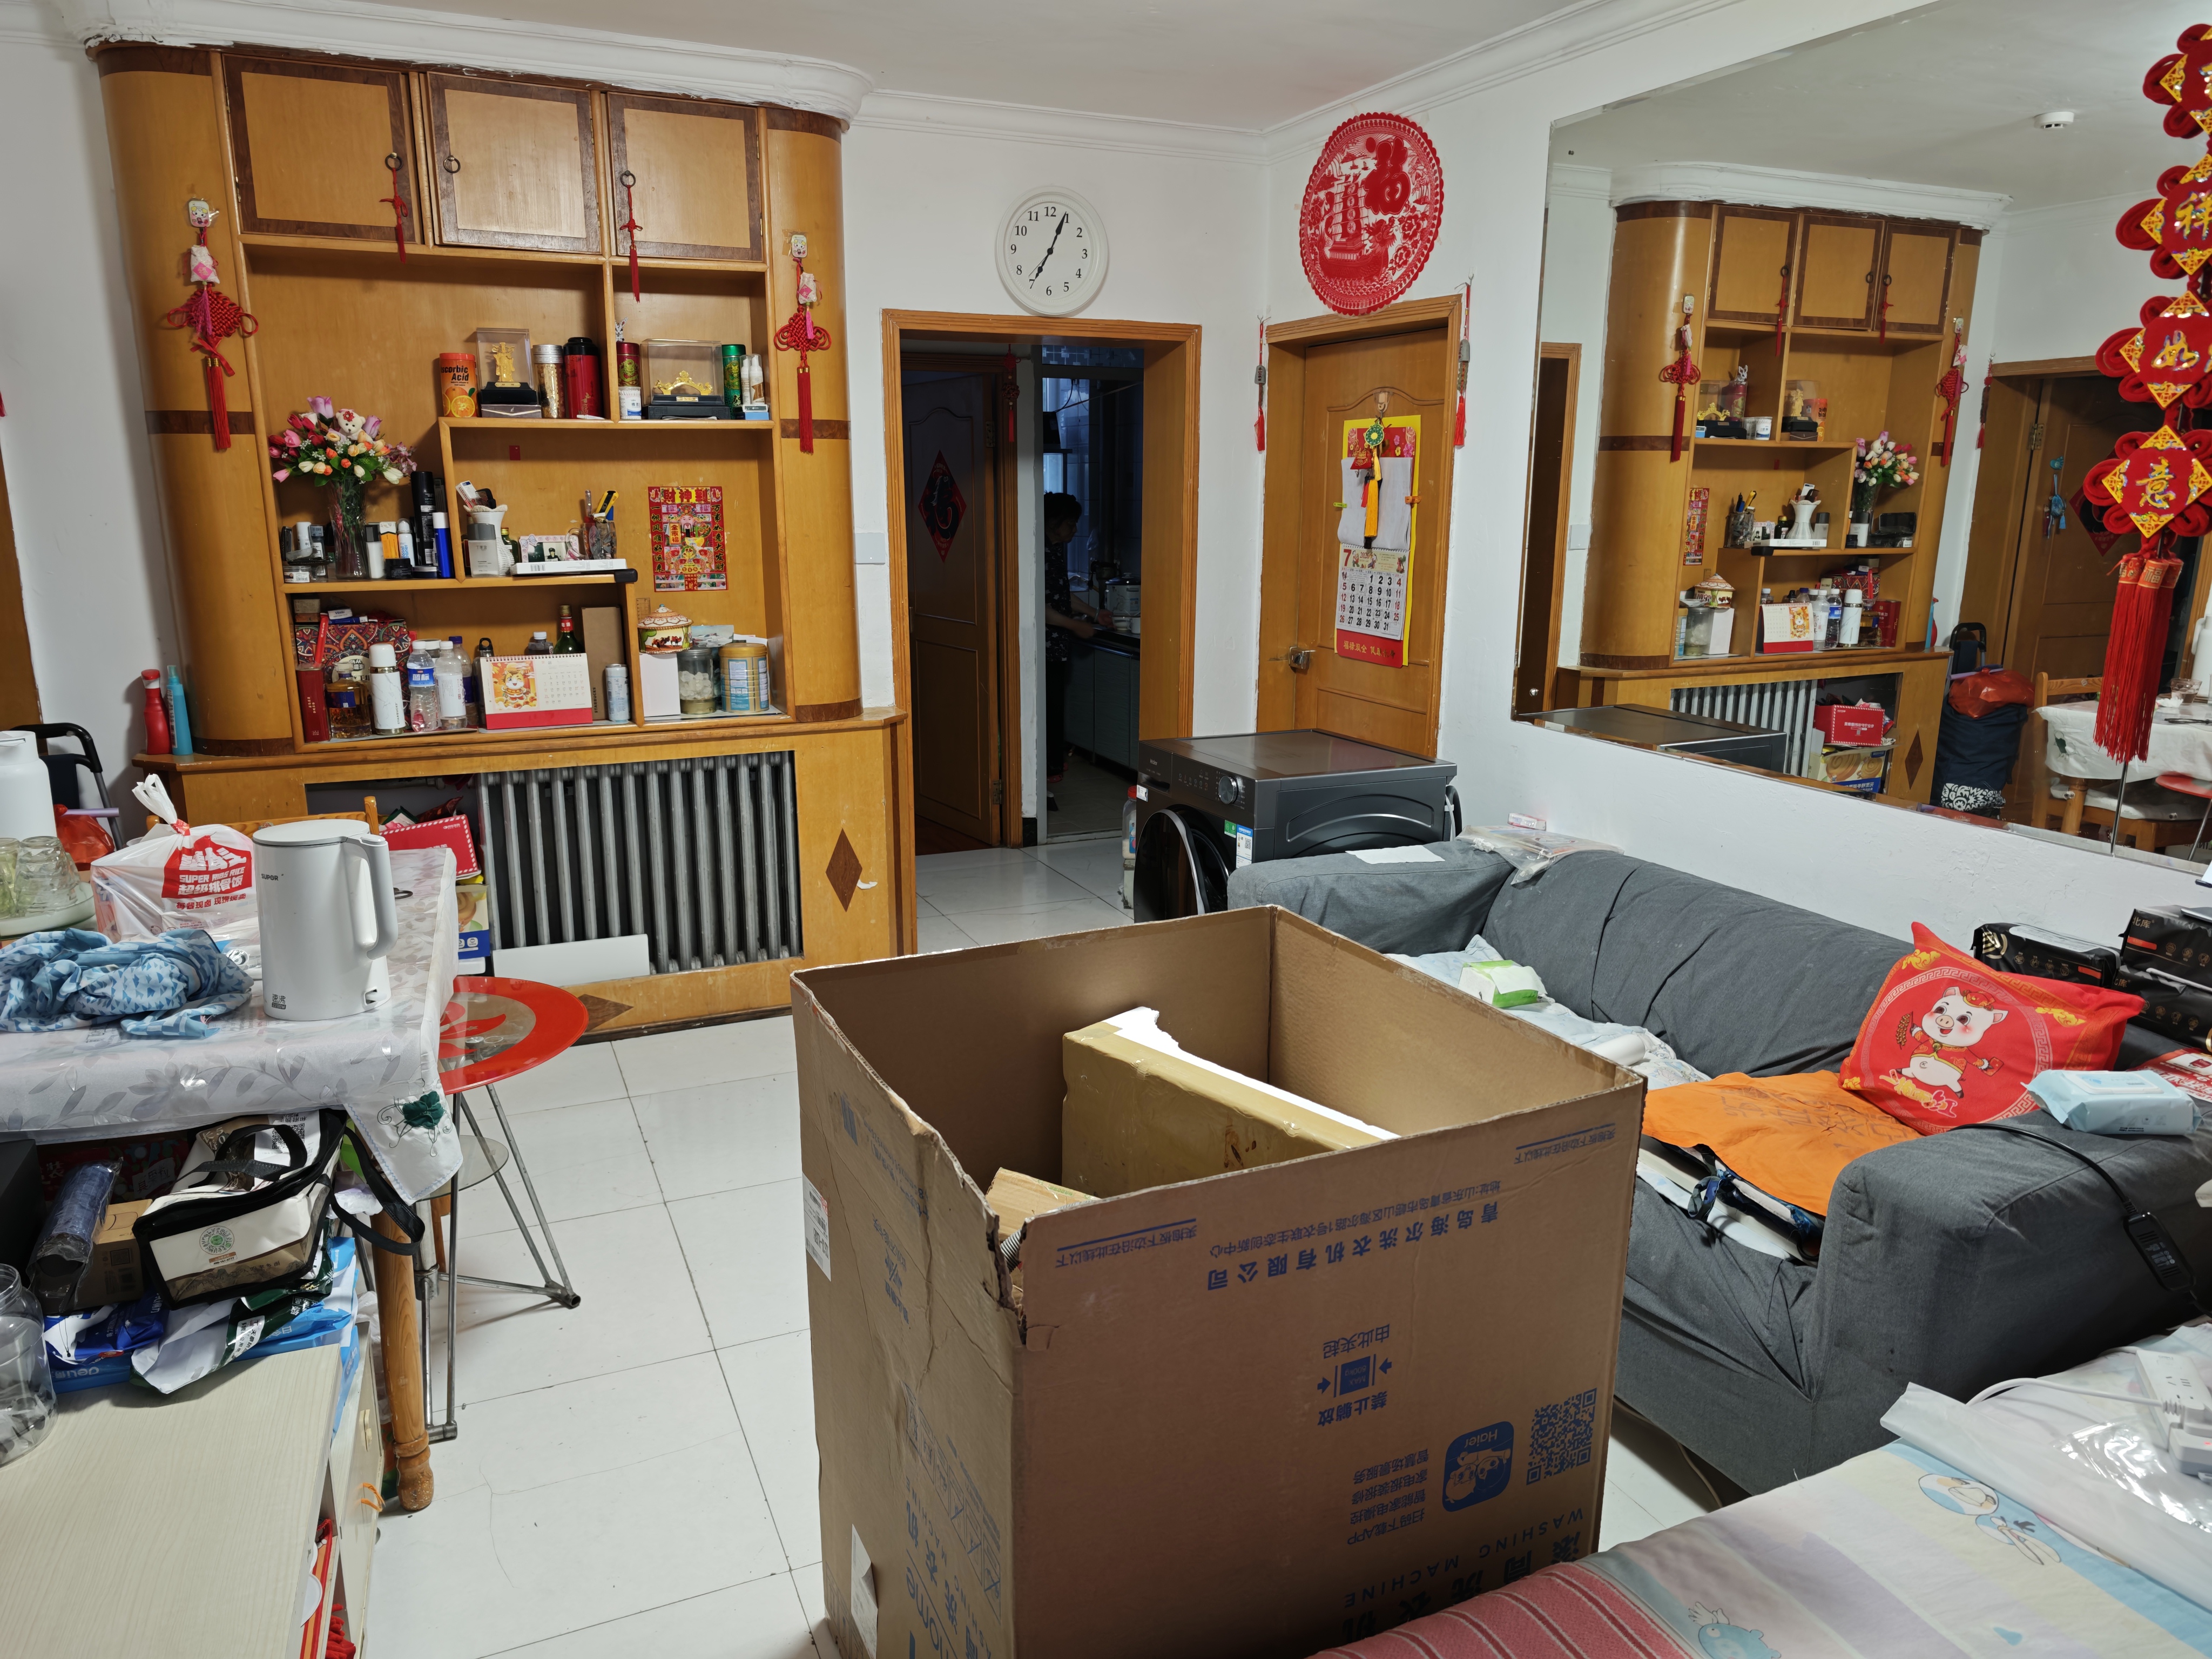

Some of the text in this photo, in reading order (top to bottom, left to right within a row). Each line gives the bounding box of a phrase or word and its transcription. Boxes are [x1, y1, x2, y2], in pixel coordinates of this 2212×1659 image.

[1028, 211, 1039, 221] 11
[1044, 207, 1056, 217] 12
[1015, 225, 1027, 236] 10
[1076, 227, 1082, 238] 2
[1010, 244, 1016, 254] 9
[1082, 248, 1088, 259] 3
[1016, 265, 1022, 275] 8
[1076, 268, 1082, 278] 4
[1029, 279, 1035, 289] 7
[1046, 286, 1051, 296] 6
[1063, 282, 1069, 292] 5
[451, 373, 469, 381] Acid
[1344, 549, 1352, 567] 7
[1370, 575, 1401, 586] 1 2 3 4
[1351, 583, 1355, 591] 6
[1368, 586, 1373, 594] 8
[1378, 587, 1382, 595] 9
[1386, 588, 1391, 597] 10
[1395, 589, 1401, 598] 11
[1341, 593, 1400, 610] 12 13 14 15 16 17 18
[1340, 604, 1346, 612] 19
[1349, 605, 1354, 613] 20
[1358, 606, 1363, 615] 21
[1366, 608, 1372, 617] 22
[1384, 611, 1390, 619] 24
[1393, 612, 1399, 621] 25
[1339, 615, 1389, 631] 26 27 28 29 30 31
[1149, 758, 1158, 766] Haier
[179, 866, 245, 884] SUPER RIBS RICE
[178, 875, 244, 895] 超级排骨饭
[272, 994, 286, 1004] 速沸
[1055, 1224, 1198, 1269] 夹抱板下边沿在此线以下
[1207, 1199, 1500, 1291] 青岛海尔洗衣机有限公司
[1323, 1323, 1392, 1360] 由此夹起
[1348, 1374, 1367, 1386] MAX
[1318, 1389, 1388, 1427] 禁止躺放
[1464, 1428, 1498, 1448] Haier
[1353, 1448, 1429, 1484] 智慧场景服务
[1351, 1468, 1428, 1506] 家电报装报修
[1350, 1488, 1427, 1525] 智能家电操控
[1347, 1507, 1426, 1546] 扫码下载APP
[1345, 1508, 1583, 1608] WASHING MACHINE
